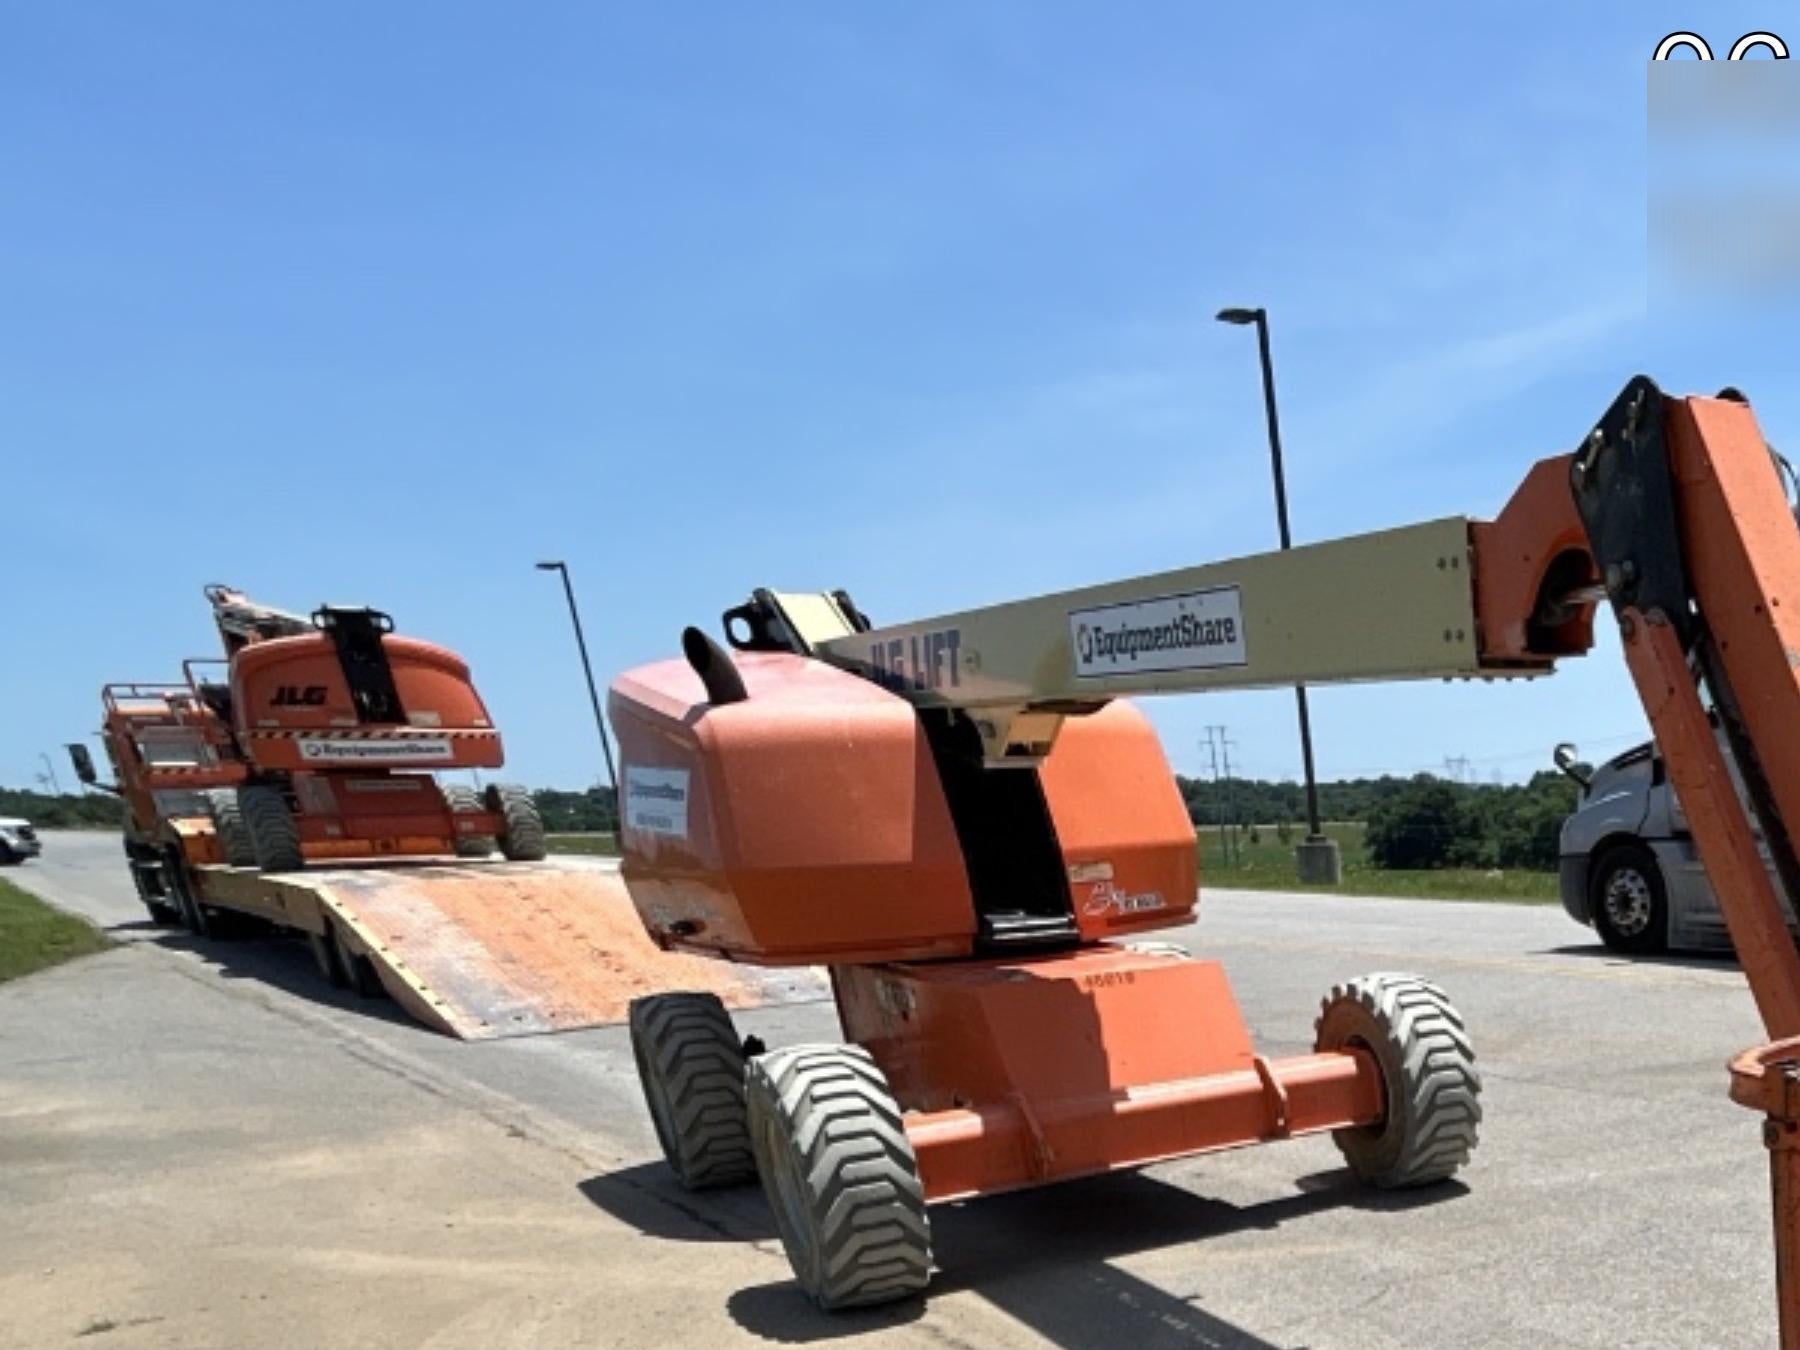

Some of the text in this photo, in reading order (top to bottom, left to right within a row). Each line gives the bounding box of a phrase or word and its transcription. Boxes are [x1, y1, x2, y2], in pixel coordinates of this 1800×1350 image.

[911, 629, 961, 690] LIFT
[1093, 613, 1236, 663] EquipmentShare
[270, 686, 329, 706] JLG
